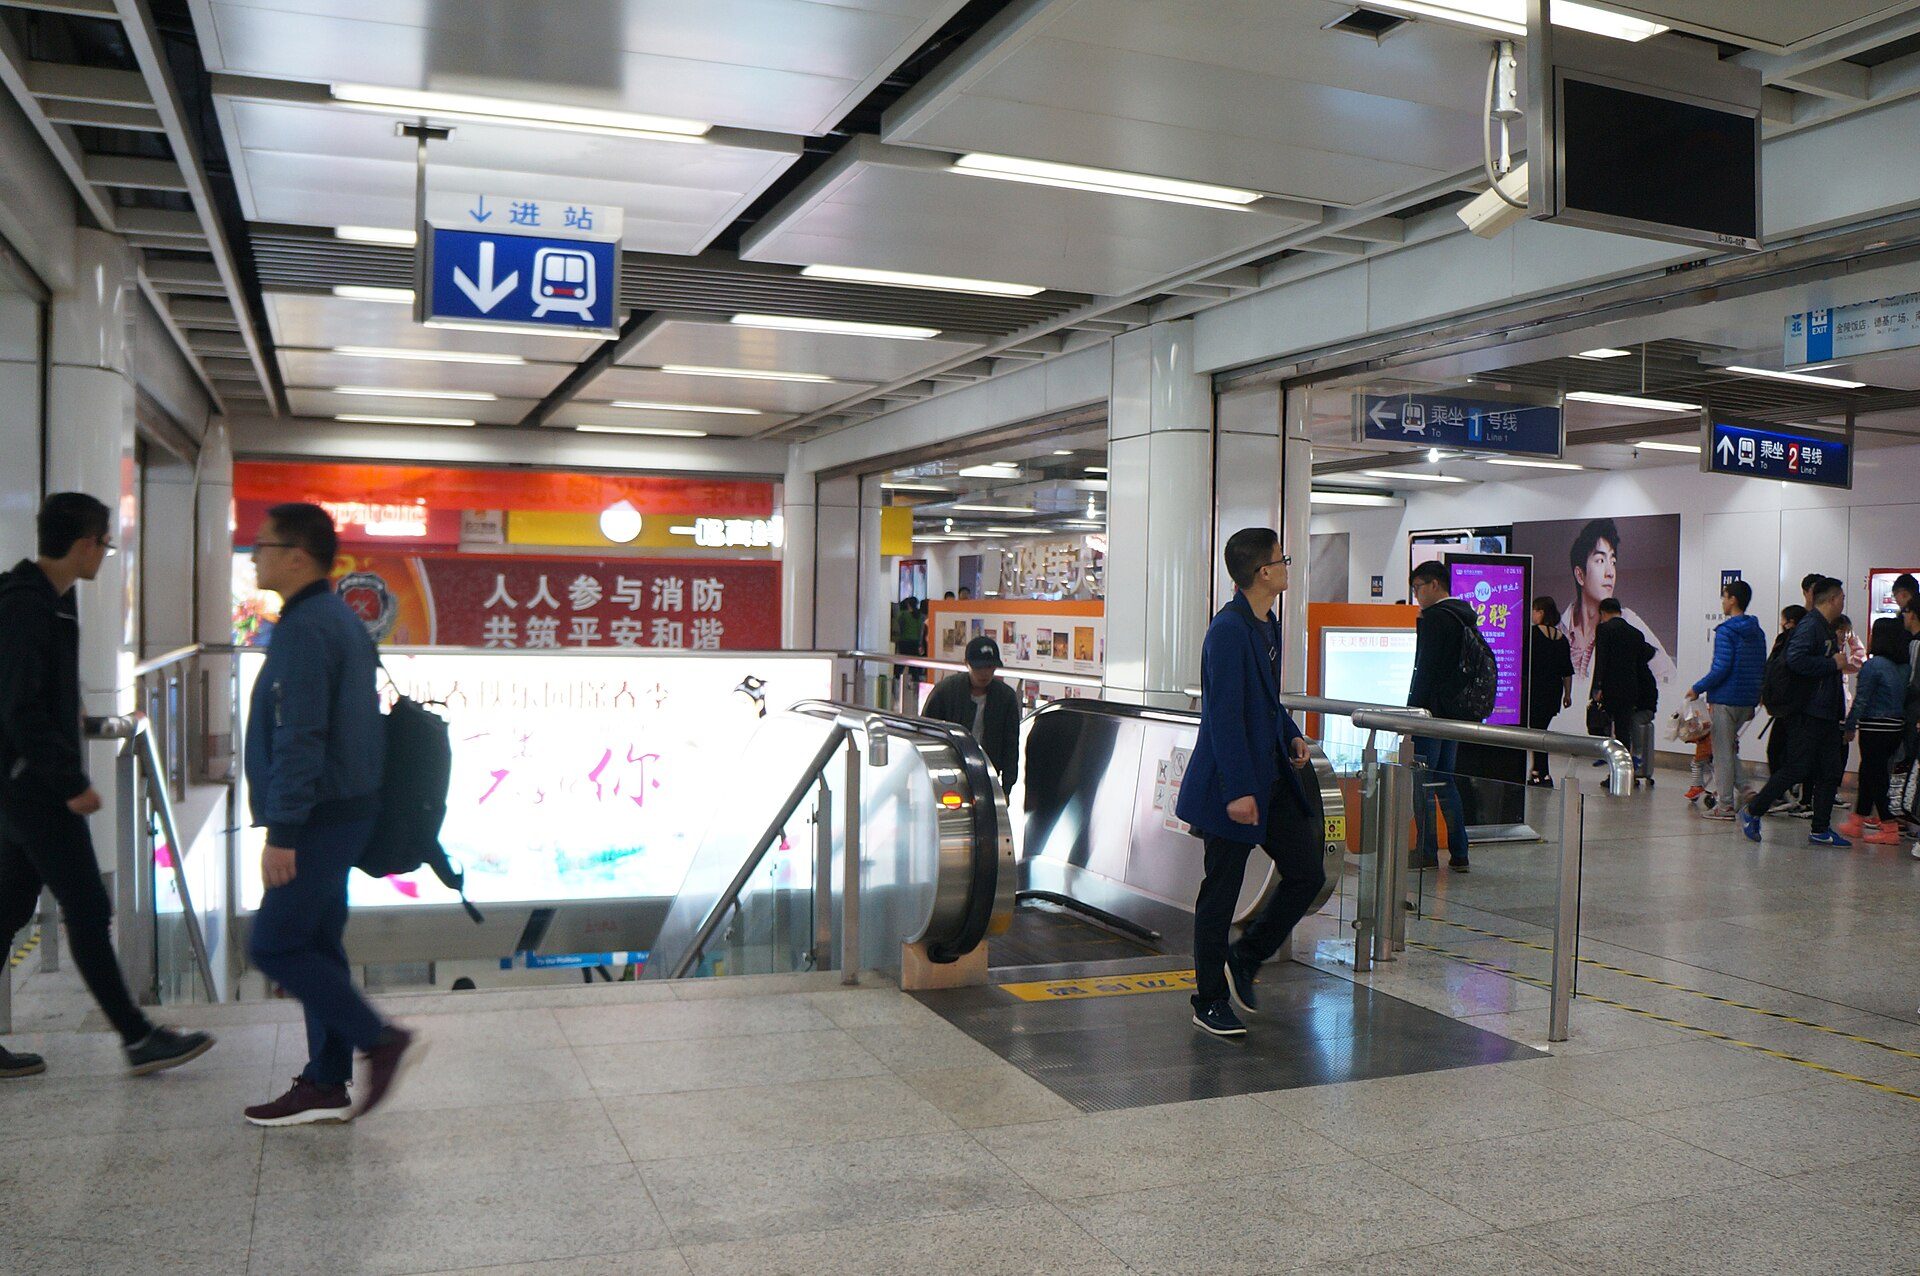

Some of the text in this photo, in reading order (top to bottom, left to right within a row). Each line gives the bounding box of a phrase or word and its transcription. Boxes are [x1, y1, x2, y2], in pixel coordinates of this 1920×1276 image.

[509, 202, 593, 230] 进站
[1812, 325, 1828, 335] EXIT
[1431, 428, 1442, 438] To
[1486, 433, 1503, 442] Line
[1760, 460, 1768, 470] To
[1801, 466, 1811, 475] Line
[483, 573, 725, 612] 人人参与消防
[483, 615, 725, 650] 共筑平安和谐
